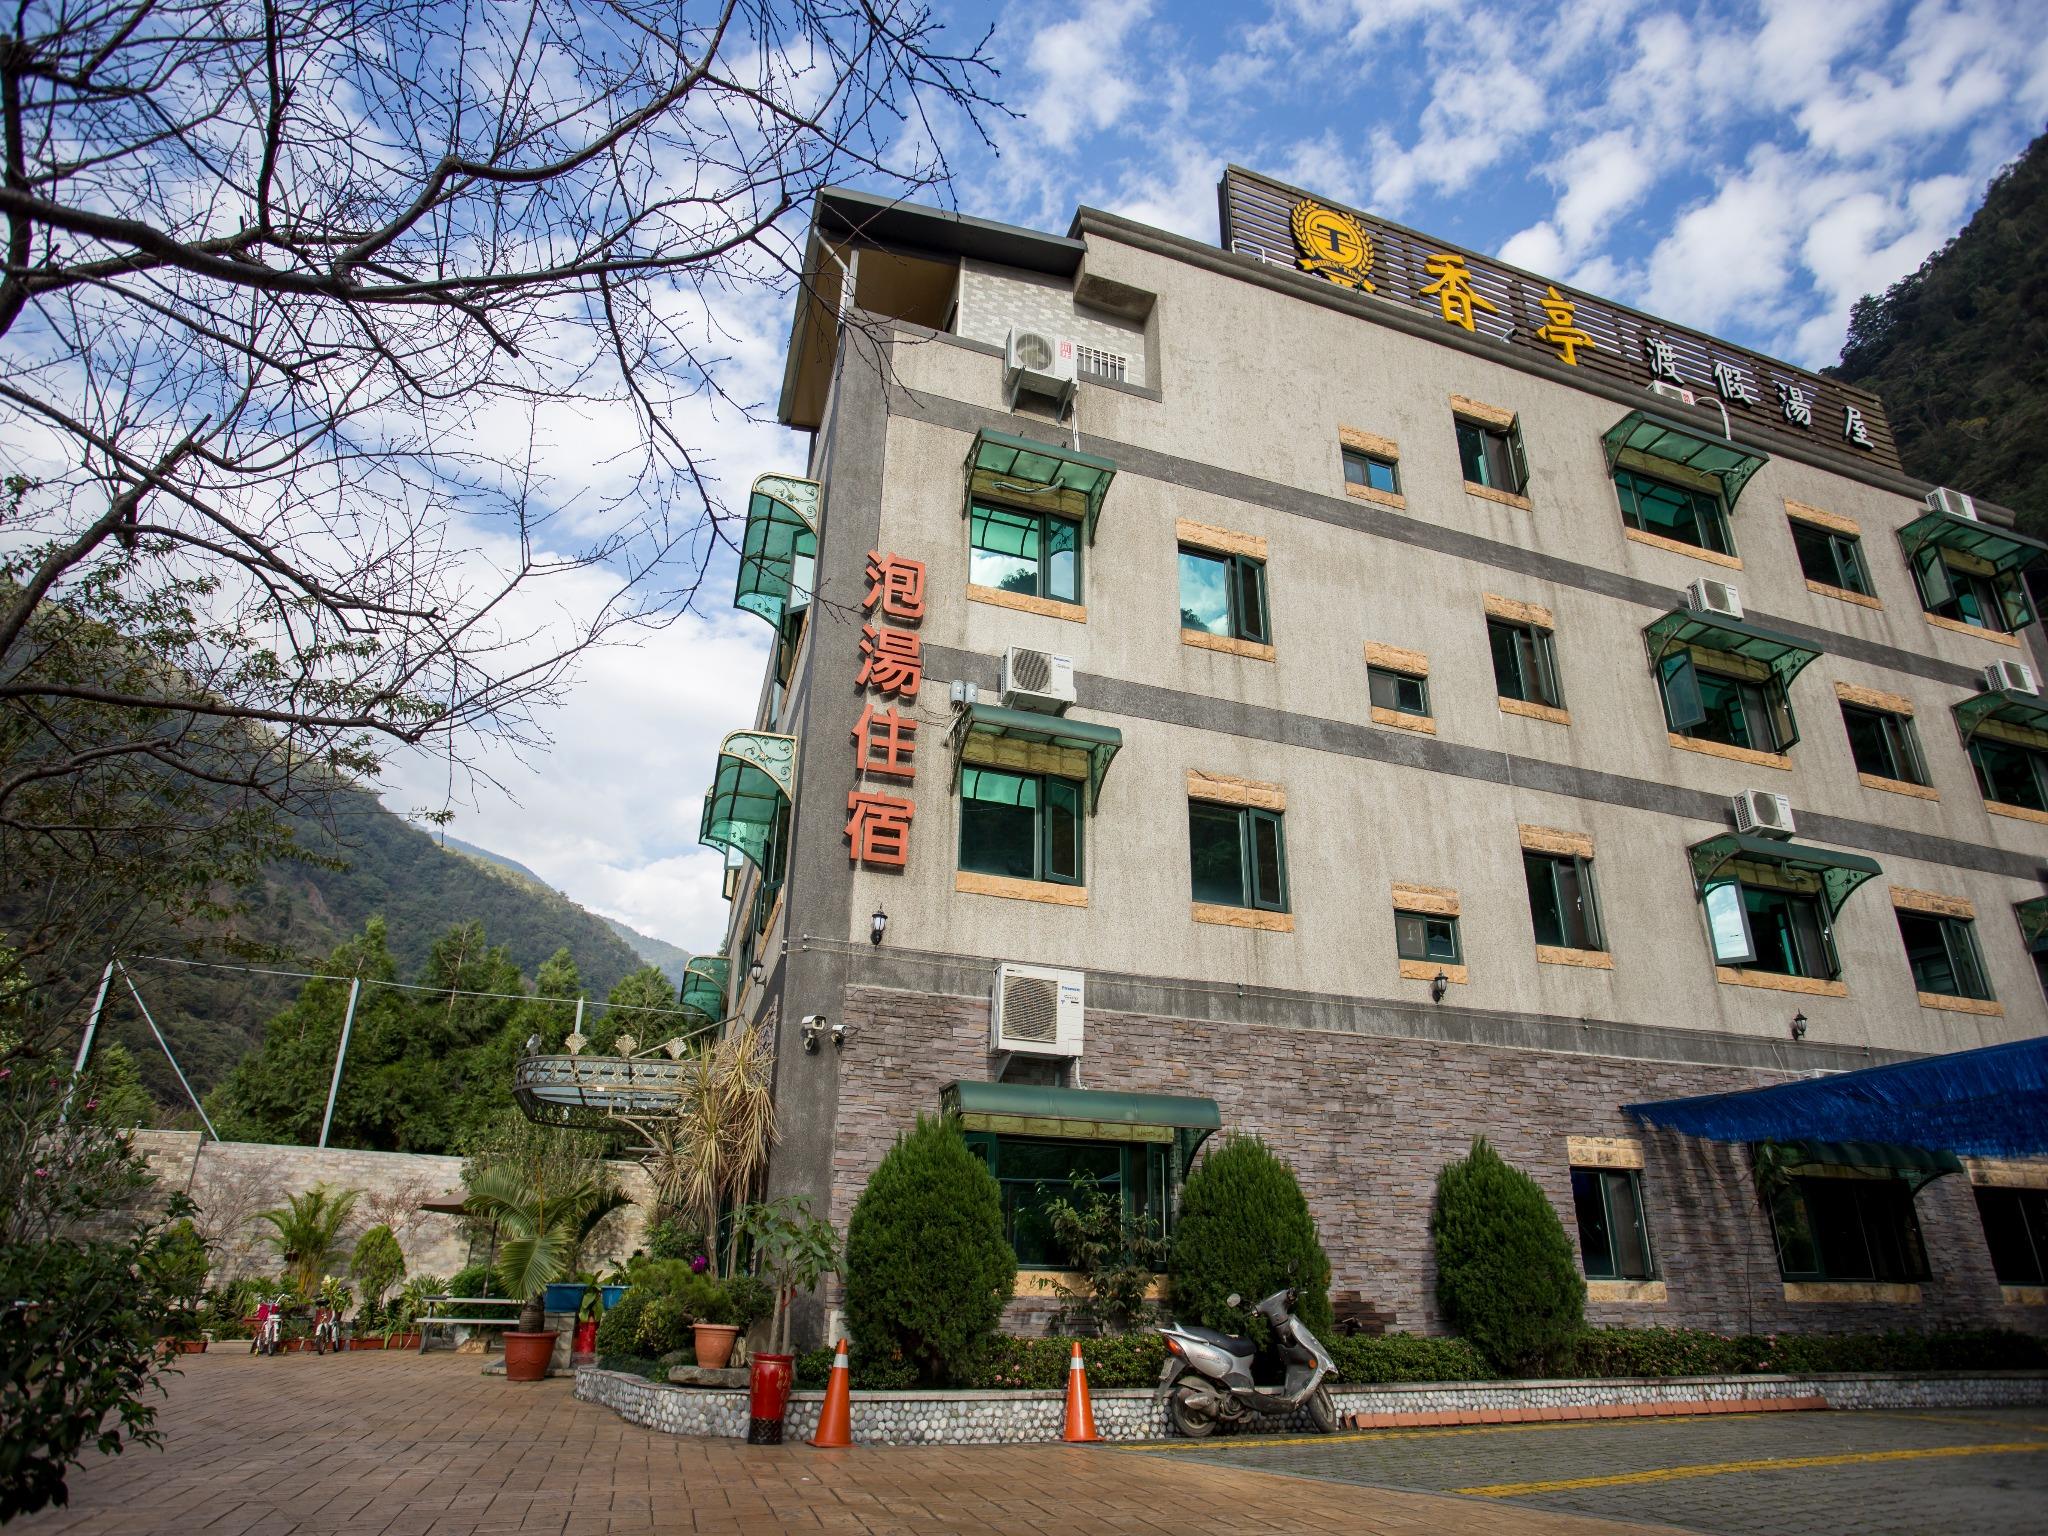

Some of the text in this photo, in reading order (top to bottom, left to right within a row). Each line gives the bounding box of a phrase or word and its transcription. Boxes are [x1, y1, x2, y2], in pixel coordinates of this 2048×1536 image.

[1418, 254, 1874, 451] 香亭 渡假湯屋
[843, 549, 926, 866] 泡湯住宿
